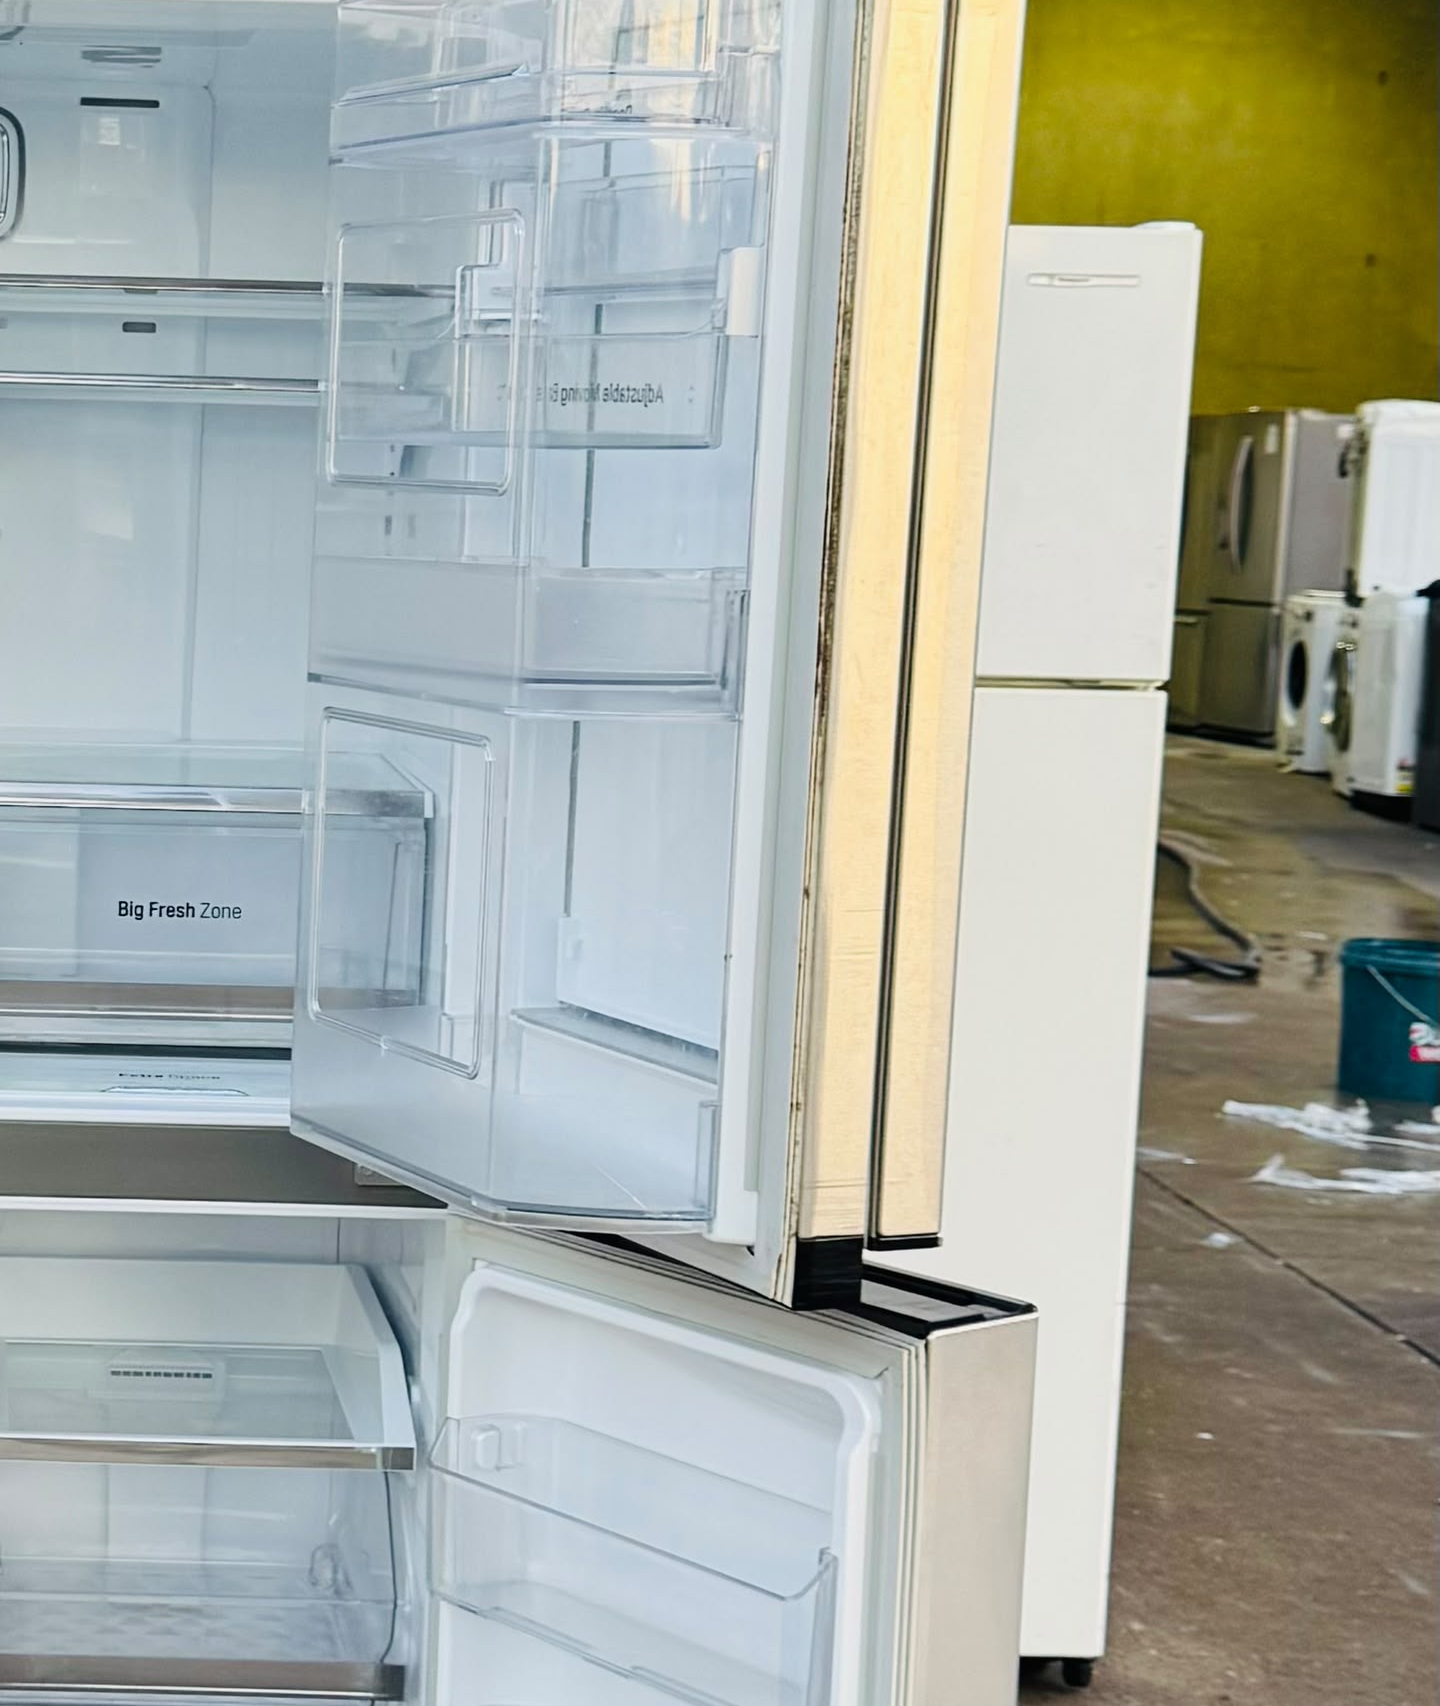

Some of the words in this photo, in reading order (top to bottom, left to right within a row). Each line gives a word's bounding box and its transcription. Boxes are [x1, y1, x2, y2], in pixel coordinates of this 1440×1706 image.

[118, 900, 144, 921] Big
[149, 901, 196, 918] Fresh
[200, 902, 242, 920] Zone
